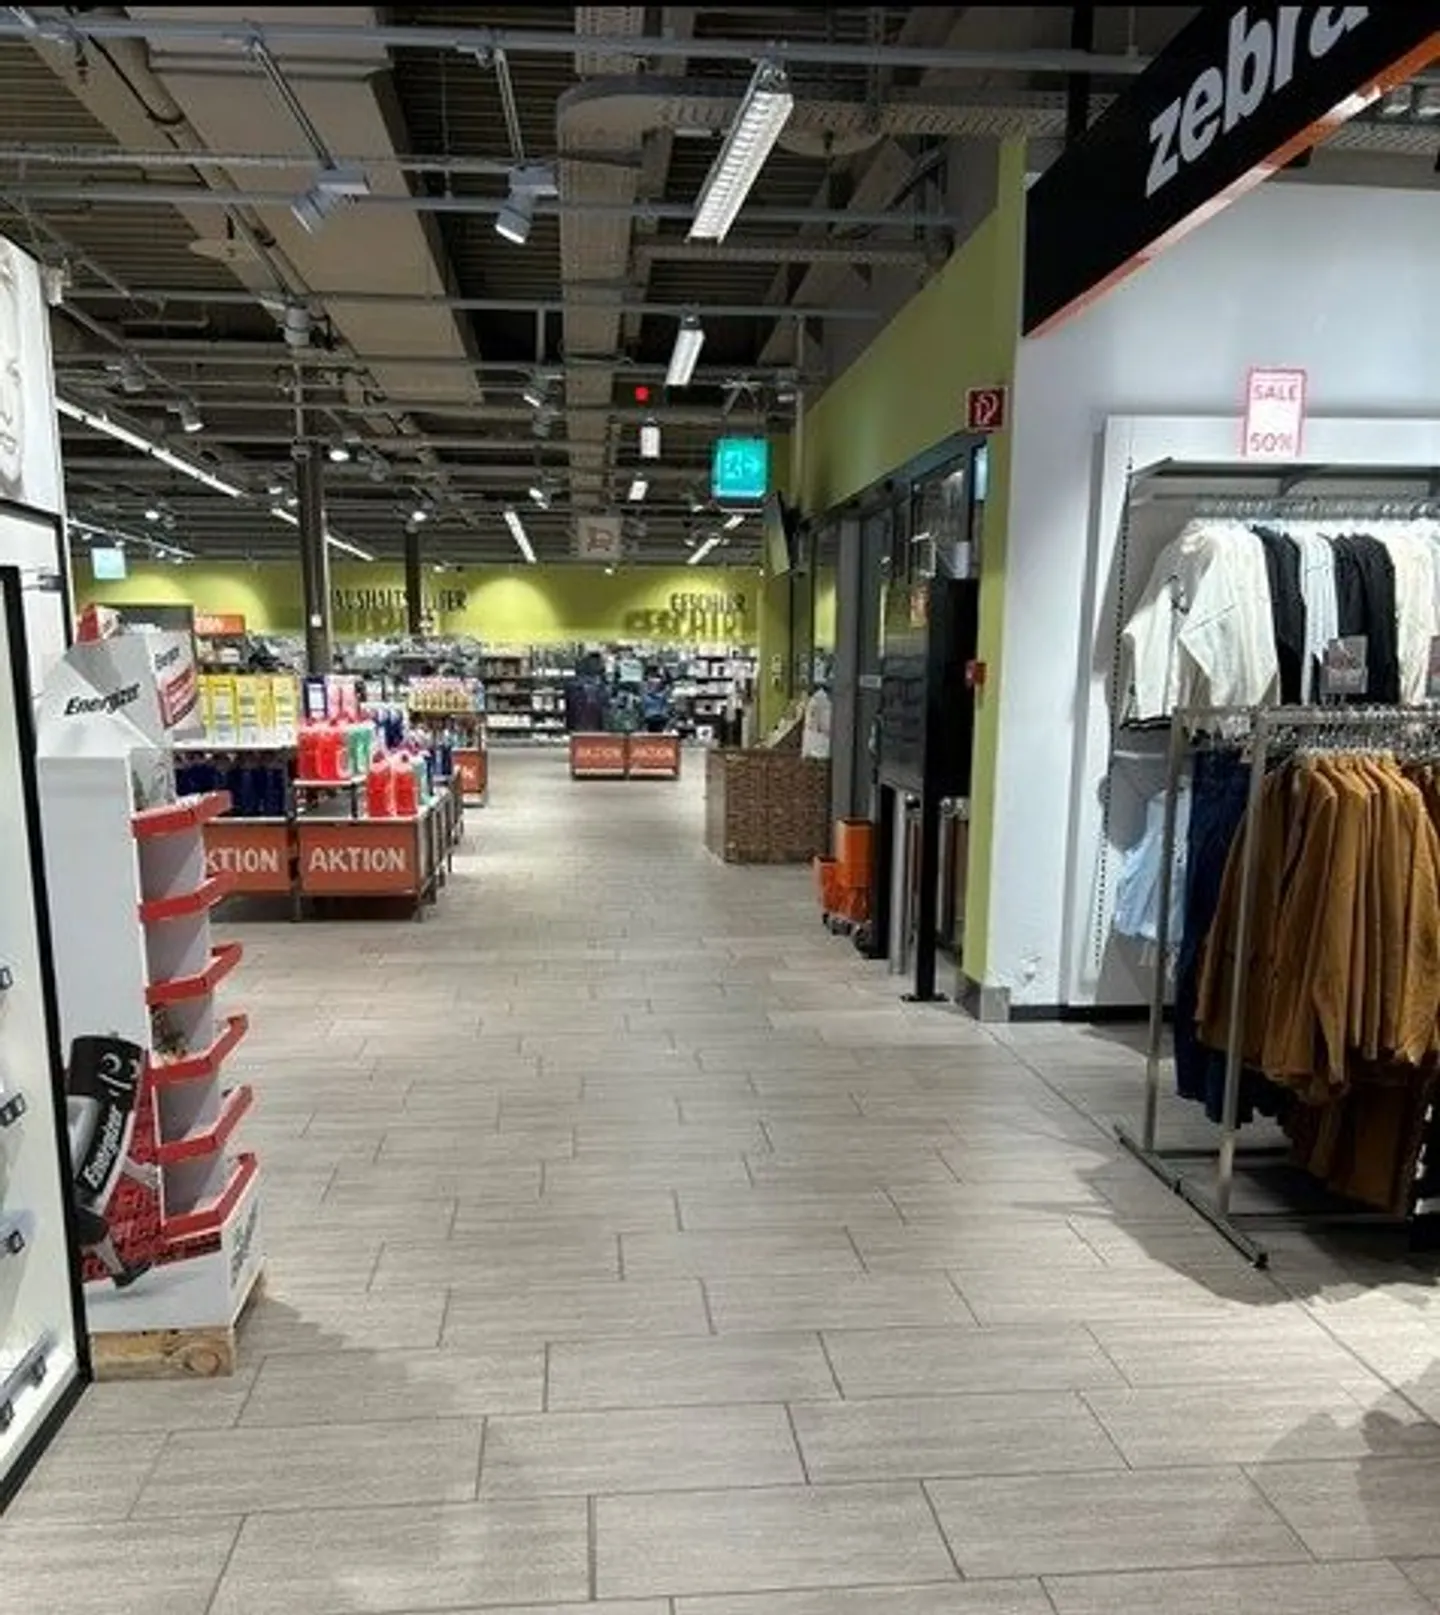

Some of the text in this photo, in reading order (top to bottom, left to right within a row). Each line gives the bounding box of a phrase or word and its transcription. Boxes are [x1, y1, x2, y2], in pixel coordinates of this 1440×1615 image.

[1253, 384, 1298, 401] SALE
[1250, 432, 1293, 452] 50%
[64, 682, 140, 715] Energizer
[205, 847, 279, 873] KTION
[309, 846, 407, 873] AKTION
[82, 1103, 123, 1189] Energizer
